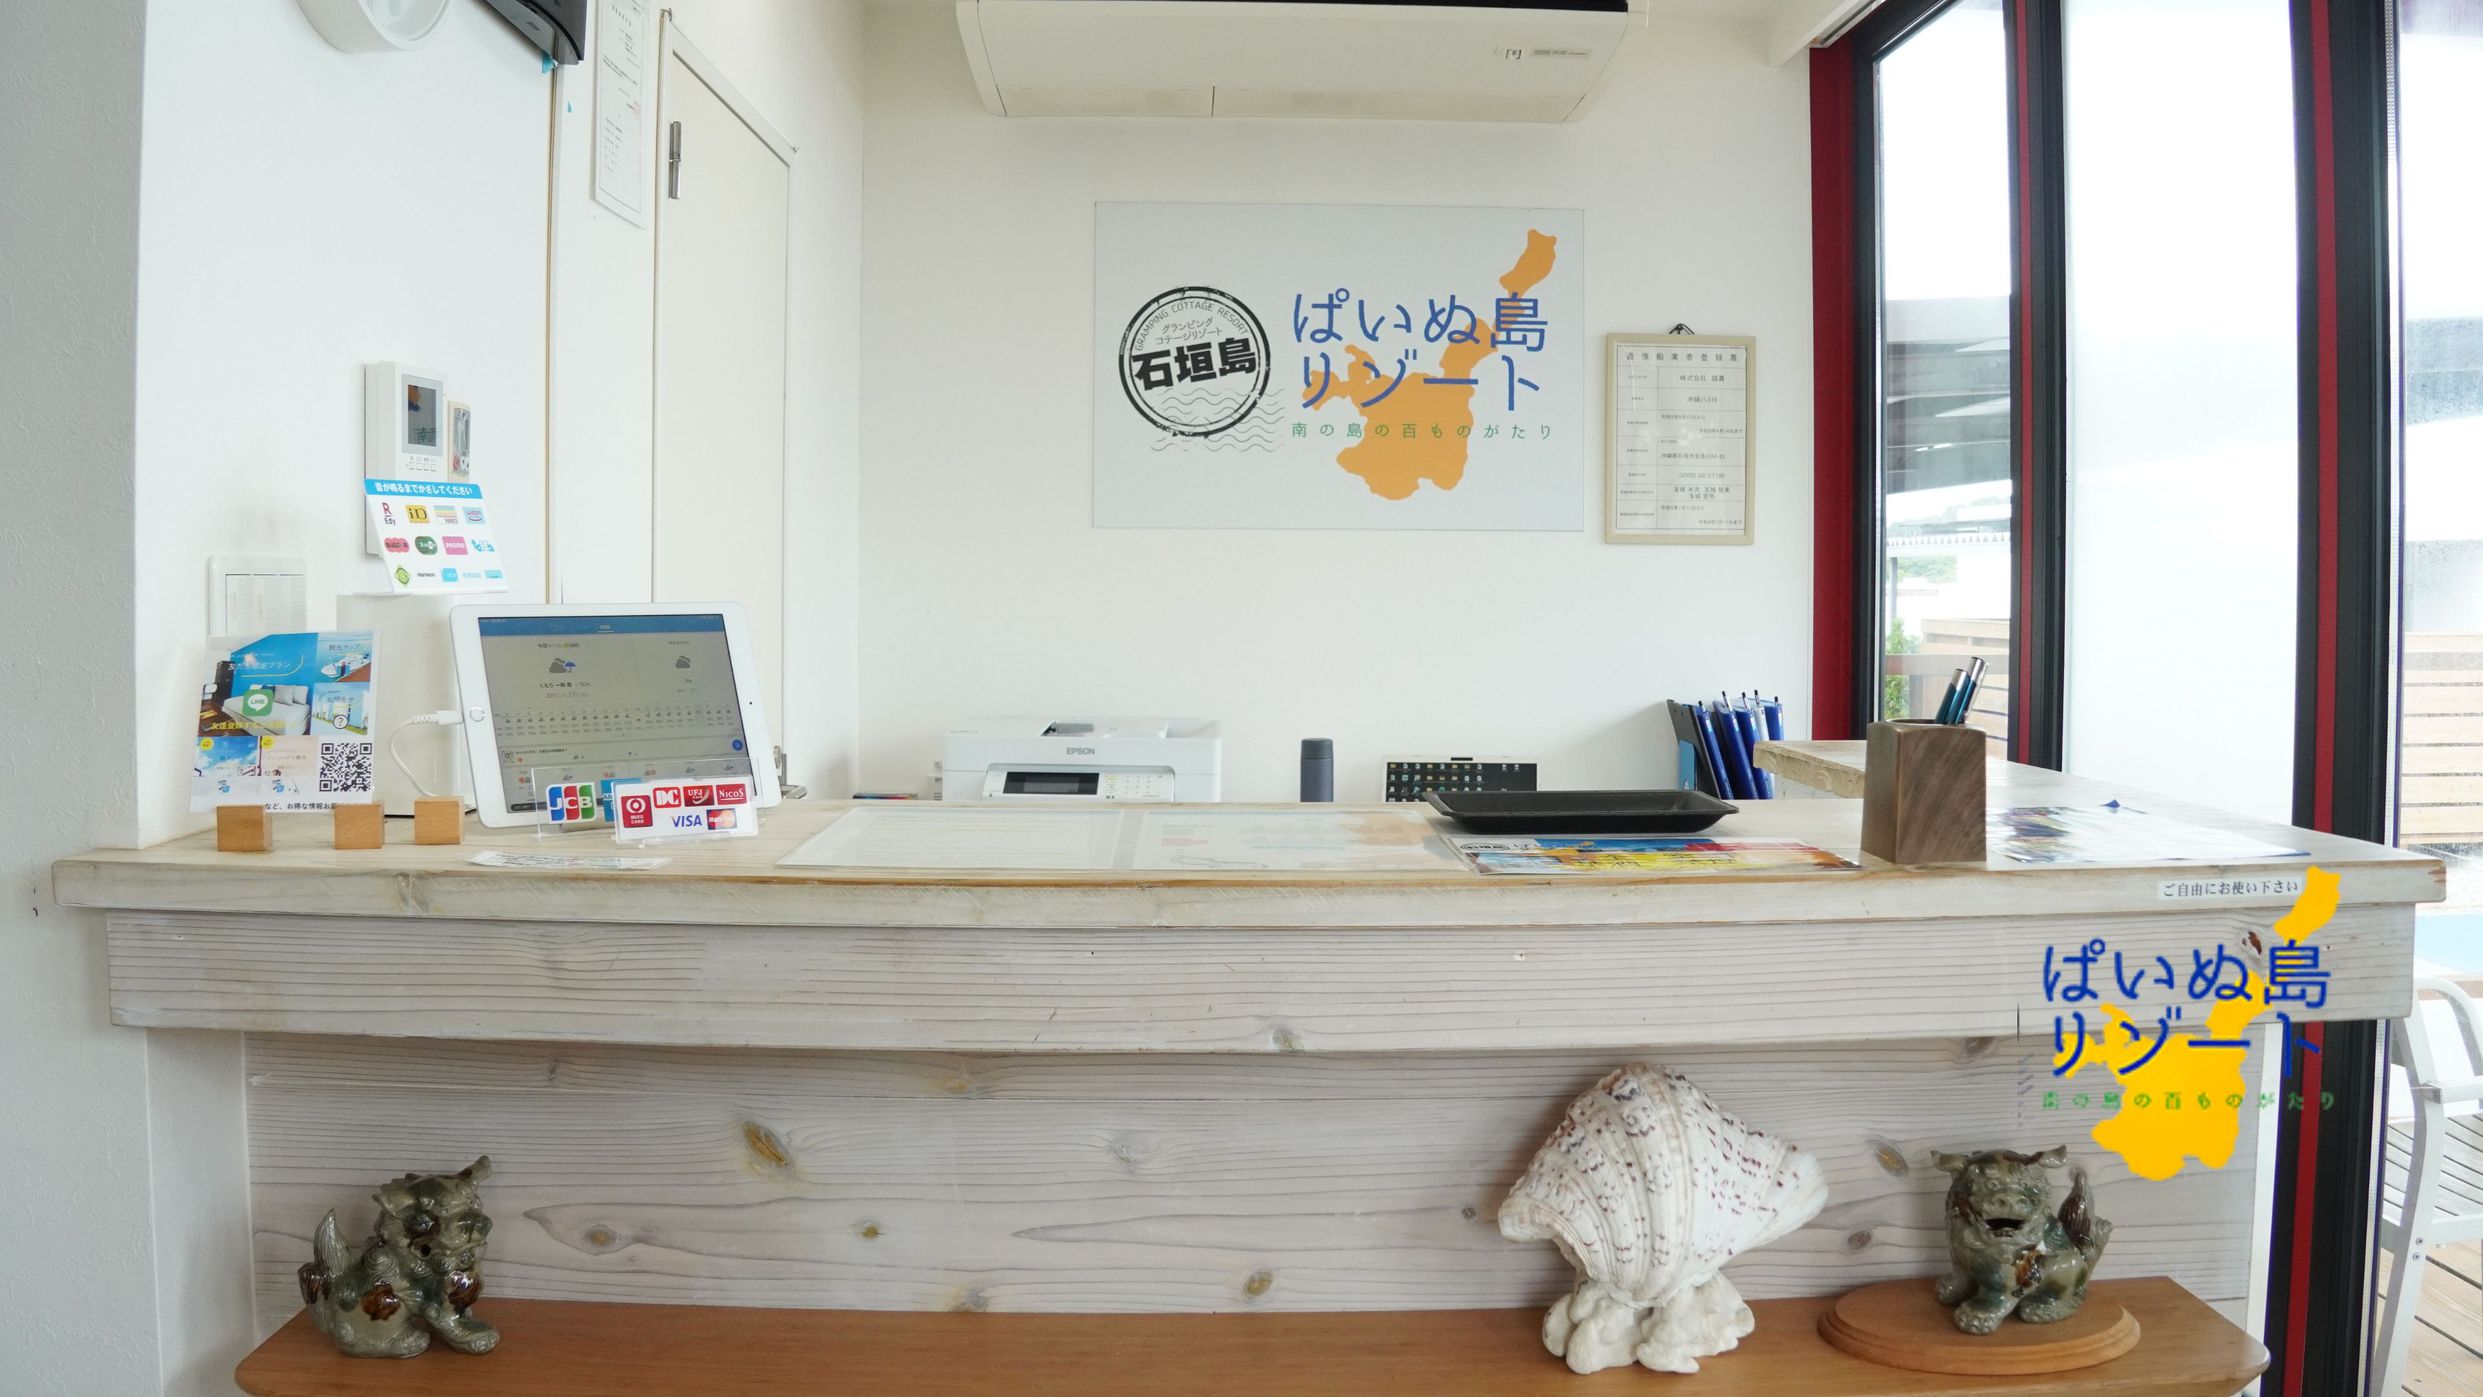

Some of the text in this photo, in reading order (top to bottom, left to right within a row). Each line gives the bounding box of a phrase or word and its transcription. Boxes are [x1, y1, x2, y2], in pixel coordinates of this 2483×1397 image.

[1134, 300, 1250, 351] GRAMPING COTTAGE RESORT
[1162, 316, 1214, 335] グランピング
[1293, 288, 1548, 353] ぱいぬ島
[1156, 327, 1223, 345] コテージリゾート
[1131, 337, 1257, 391] 石垣島
[1302, 348, 1540, 412] リゾート
[1291, 421, 1551, 440] 南の島の百ものがたり
[384, 517, 396, 526] Edy
[408, 507, 428, 520] iD
[1067, 746, 1095, 755] EPSON
[655, 789, 679, 806] DC
[688, 788, 703, 796] UFJ
[671, 815, 702, 828] VISA
[2163, 879, 2299, 898] ご自由にお使い下さい
